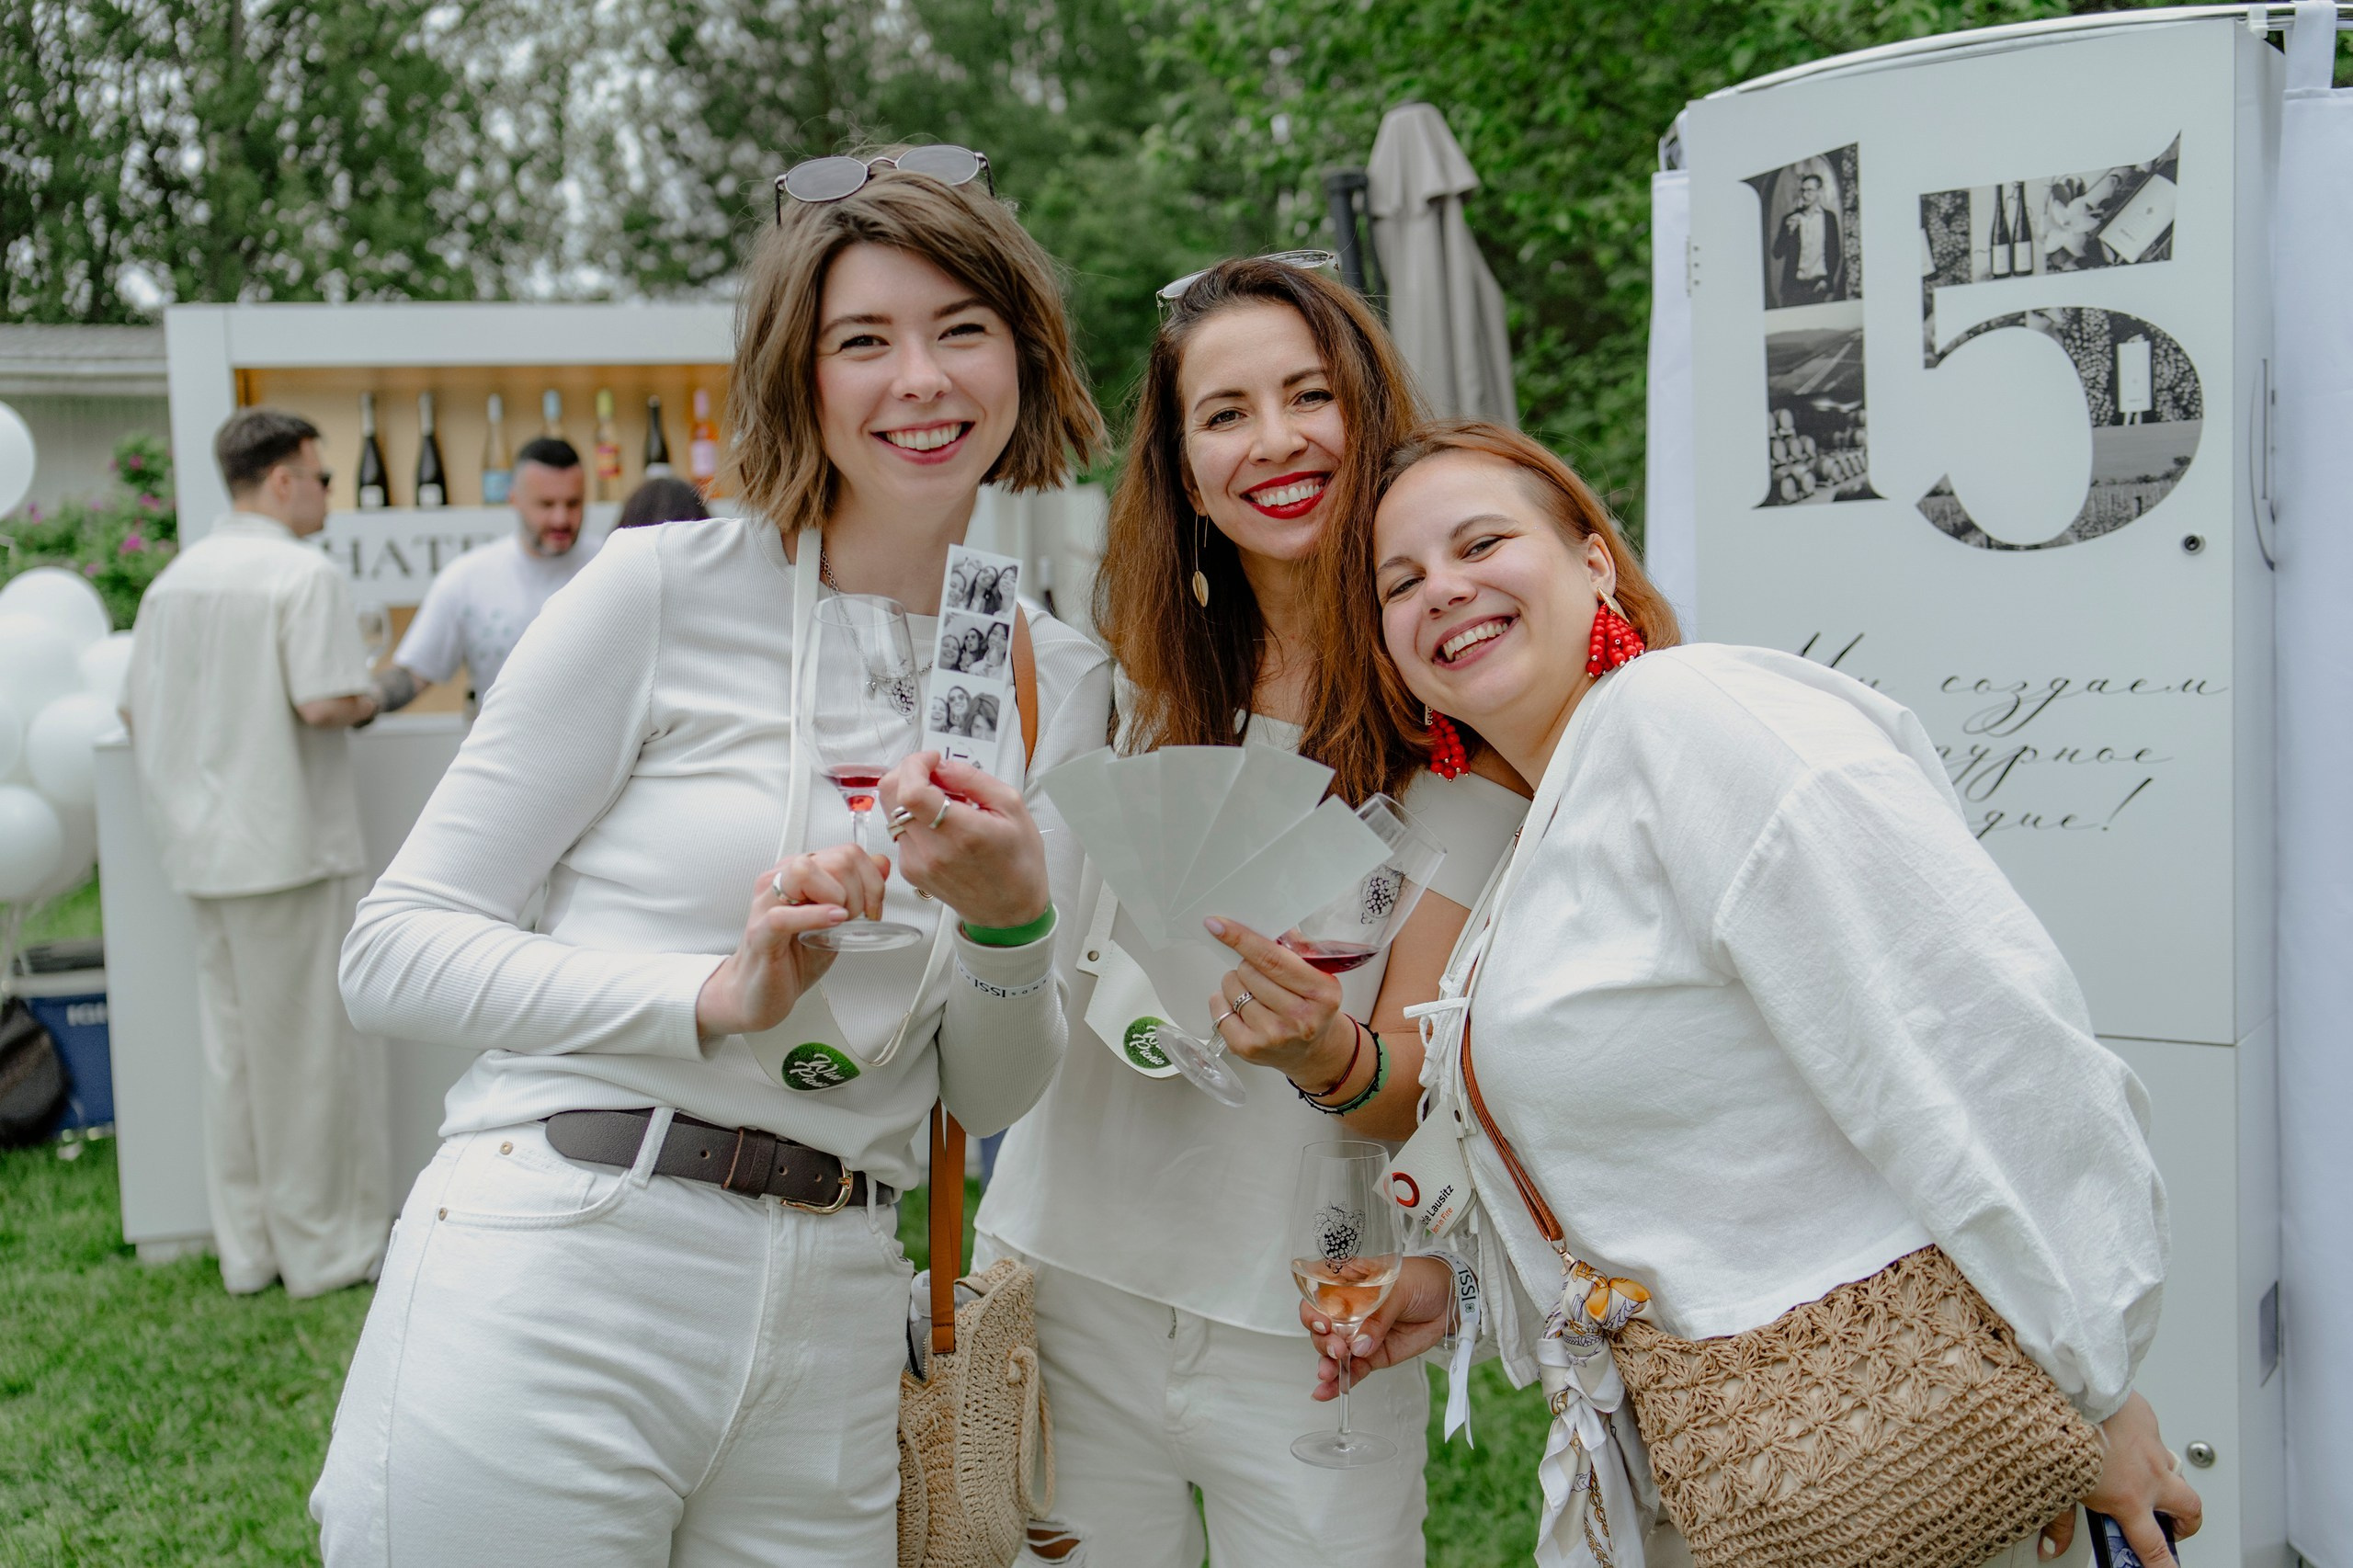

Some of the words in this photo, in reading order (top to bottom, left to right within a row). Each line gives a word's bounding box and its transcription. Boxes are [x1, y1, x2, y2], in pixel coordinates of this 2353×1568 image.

[1739, 130, 2203, 551] 15
[1940, 675, 2229, 736] создаем
[974, 979, 1006, 998] ISSI
[1428, 1184, 1454, 1217] Lausitz
[1440, 1207, 1453, 1220] Fire
[1459, 1269, 1476, 1301] ISSI
